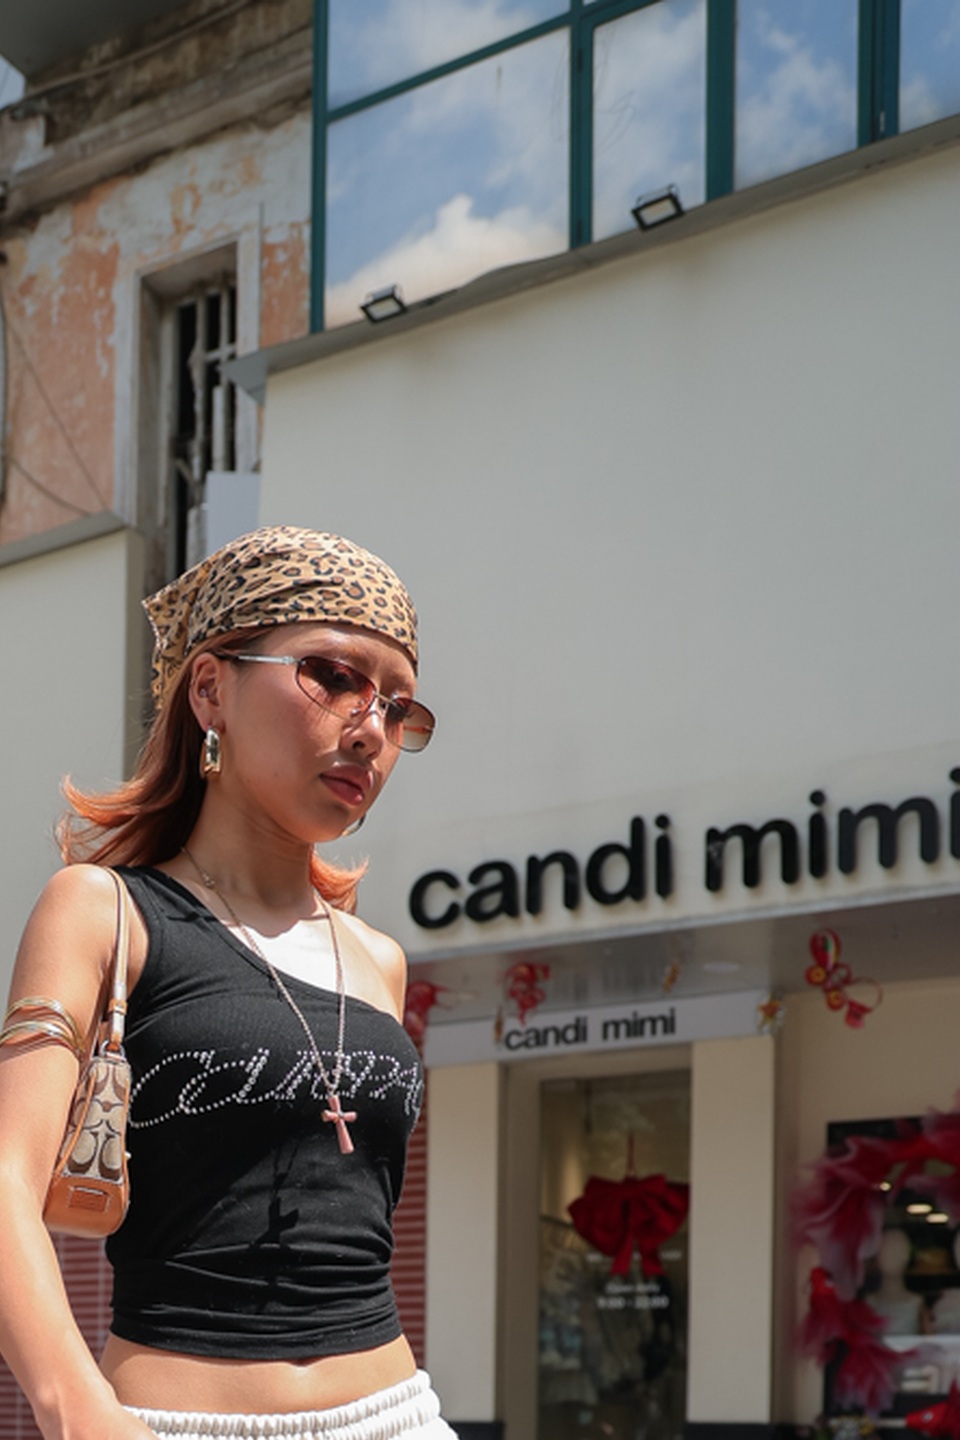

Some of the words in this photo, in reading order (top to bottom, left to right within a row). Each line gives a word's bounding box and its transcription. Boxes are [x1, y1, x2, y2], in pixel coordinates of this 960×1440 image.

[408, 813, 672, 930] candi
[504, 1016, 587, 1050] candi
[602, 1007, 676, 1041] mimi
